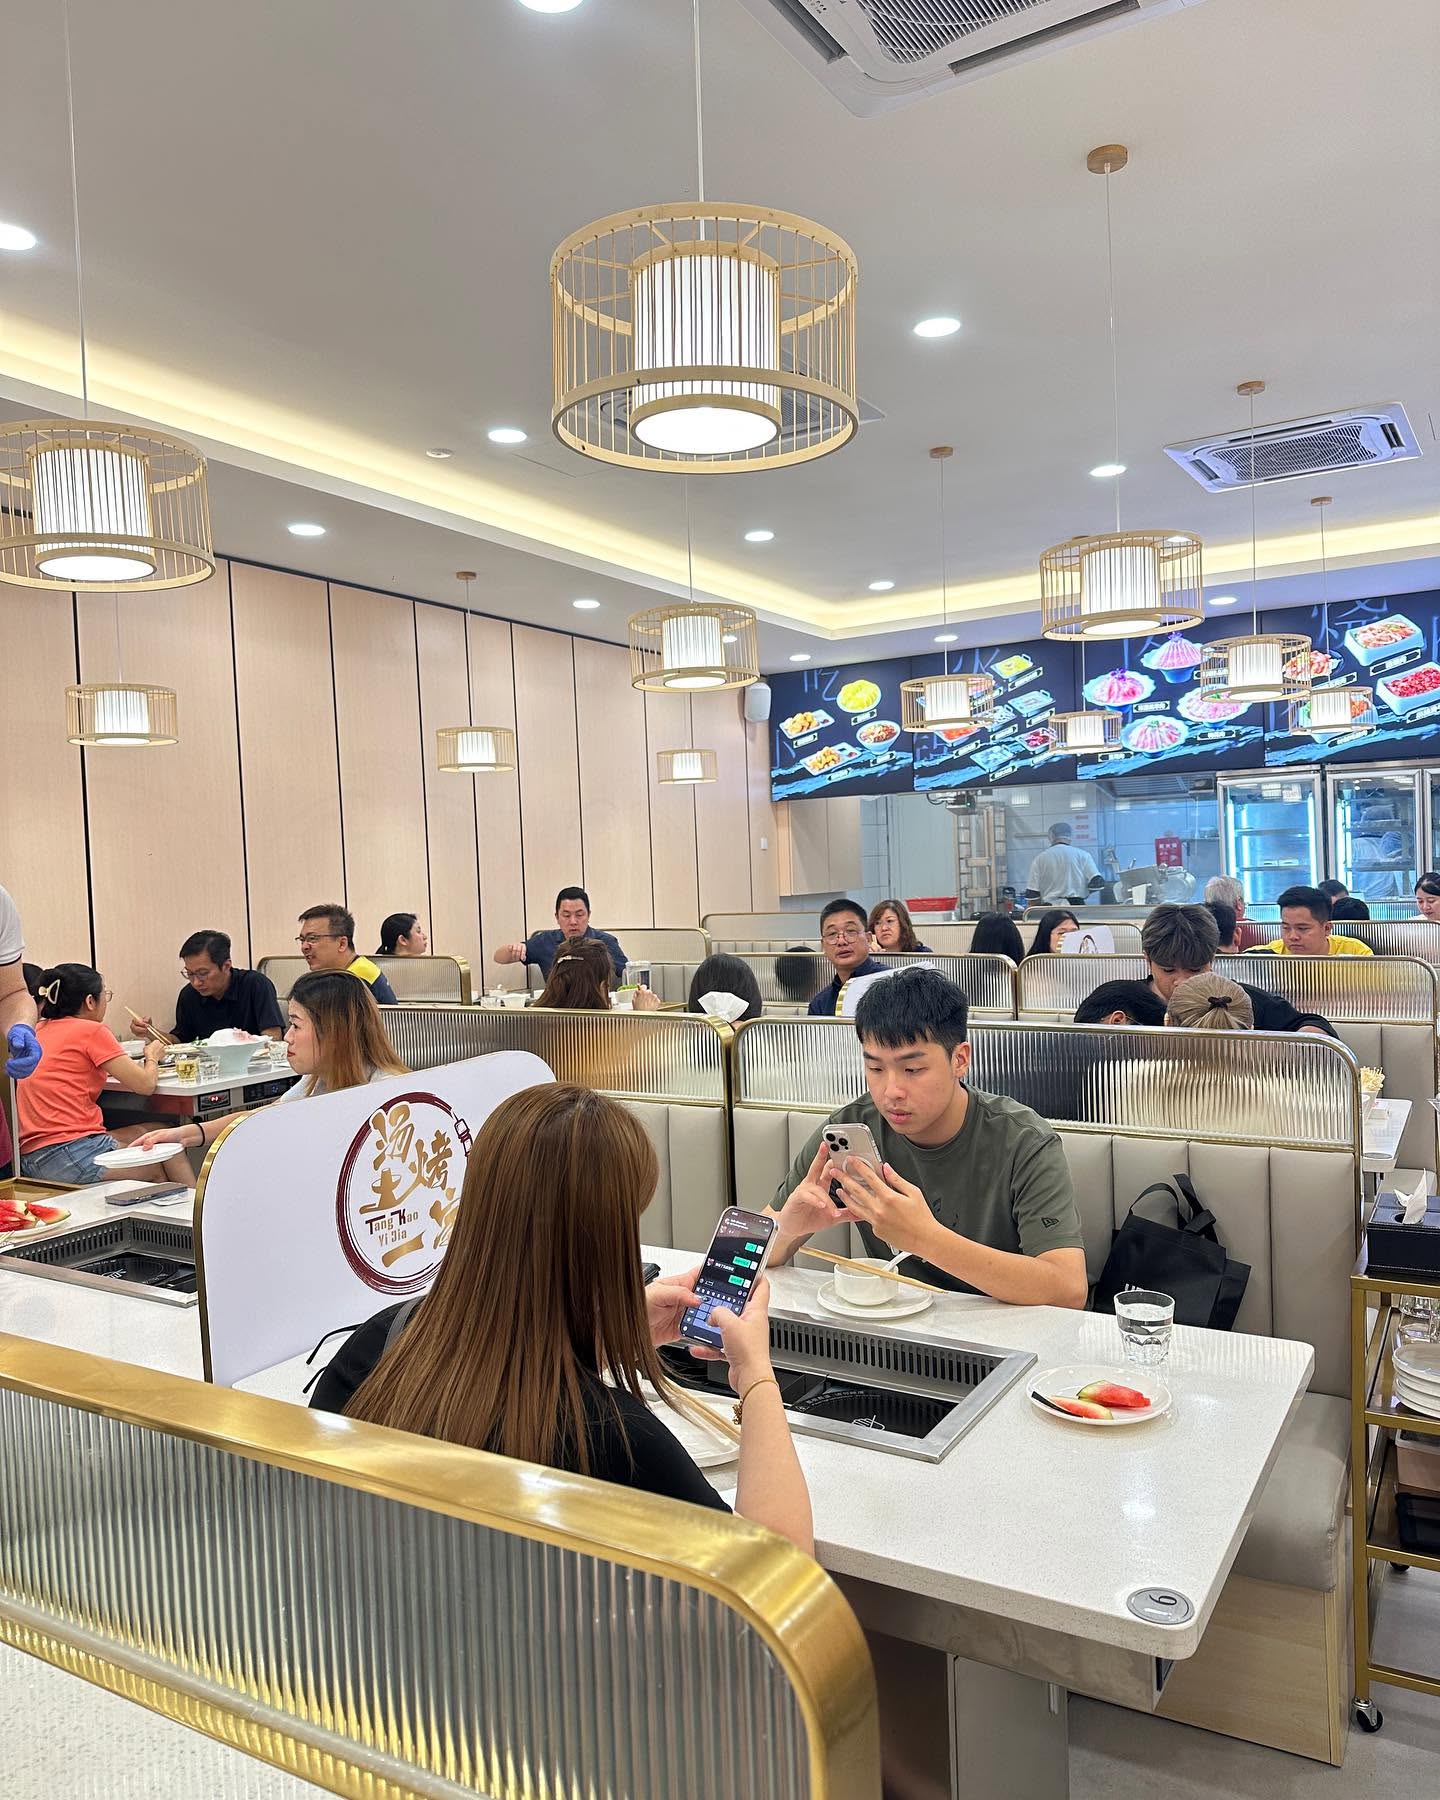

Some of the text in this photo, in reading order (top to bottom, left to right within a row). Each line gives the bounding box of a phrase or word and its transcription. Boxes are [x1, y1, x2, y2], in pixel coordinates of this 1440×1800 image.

[365, 1208, 419, 1235] Tang Kao
[378, 1232, 389, 1247] Yi
